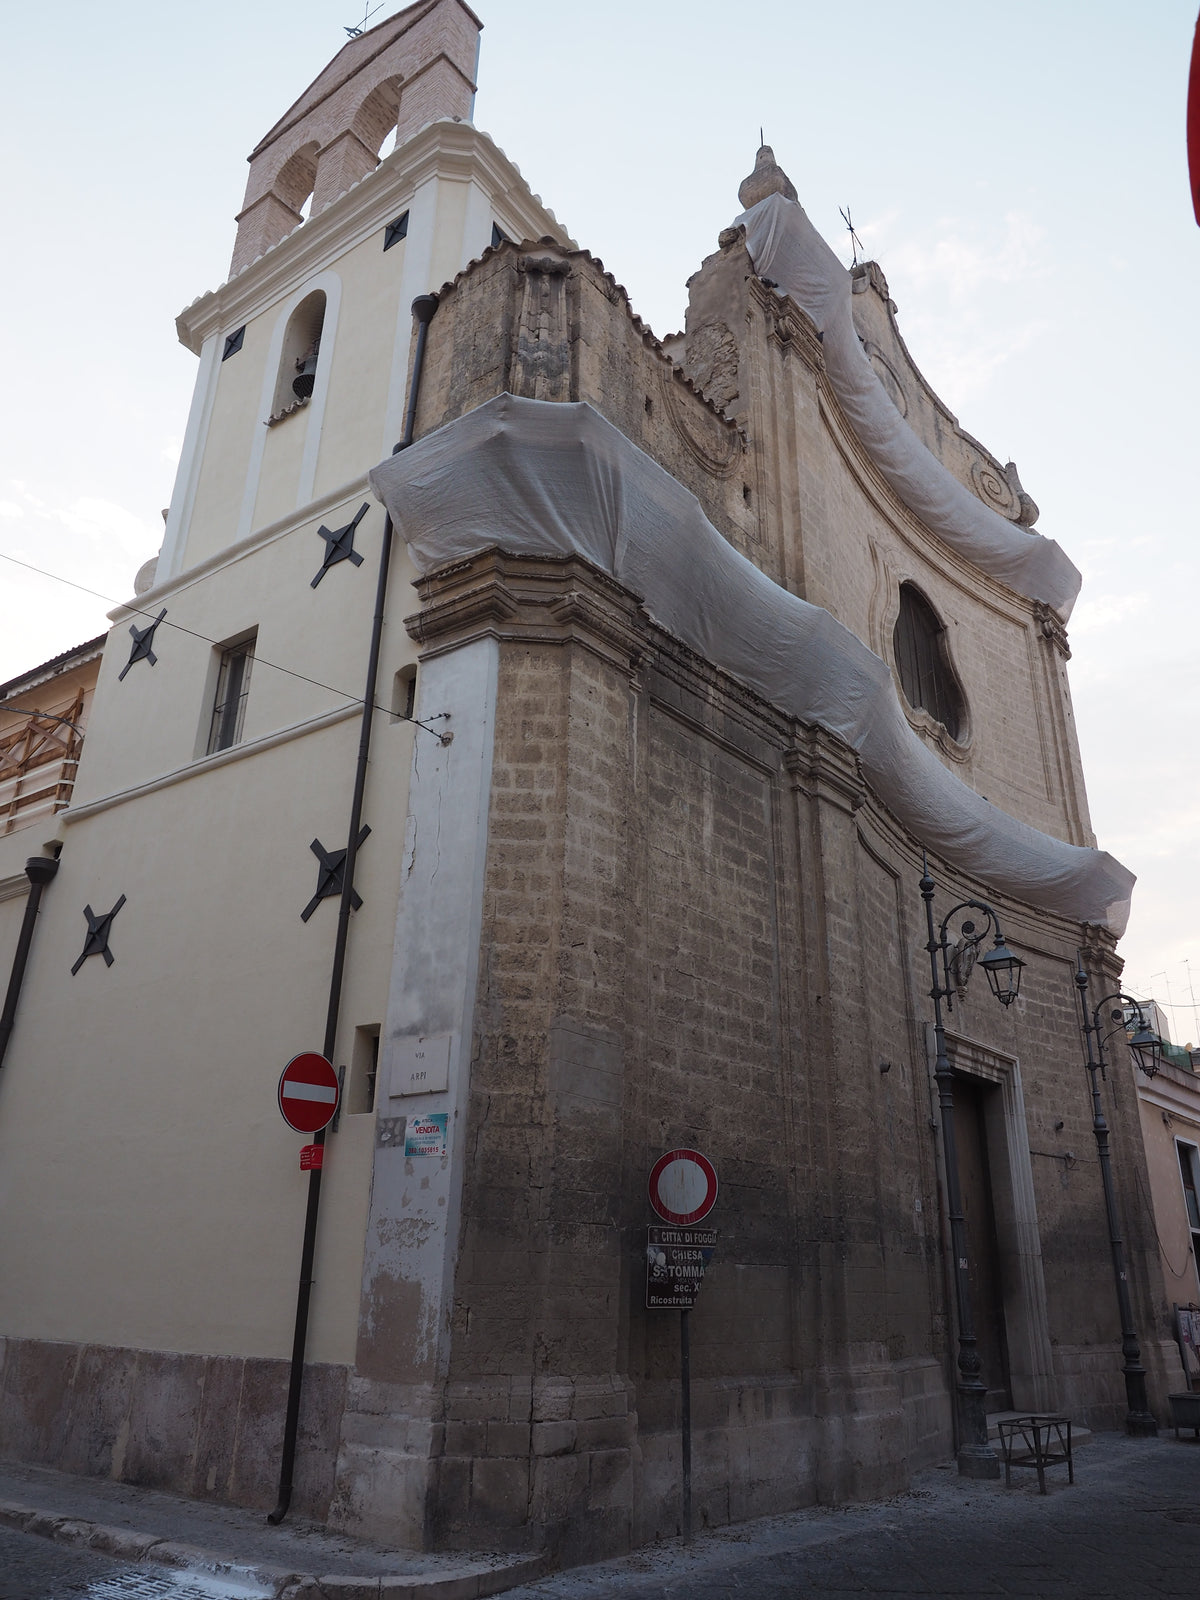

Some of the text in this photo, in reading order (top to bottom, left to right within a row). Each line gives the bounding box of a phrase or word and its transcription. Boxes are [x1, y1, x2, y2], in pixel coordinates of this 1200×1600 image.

[410, 1072, 427, 1080] ARPI
[415, 1125, 440, 1134] VENDITA
[684, 1232, 693, 1243] DI
[672, 1250, 703, 1260] CHIESA
[668, 1265, 705, 1277] TOMMA
[674, 1284, 692, 1293] sec.
[650, 1295, 692, 1304] Ricostruita
